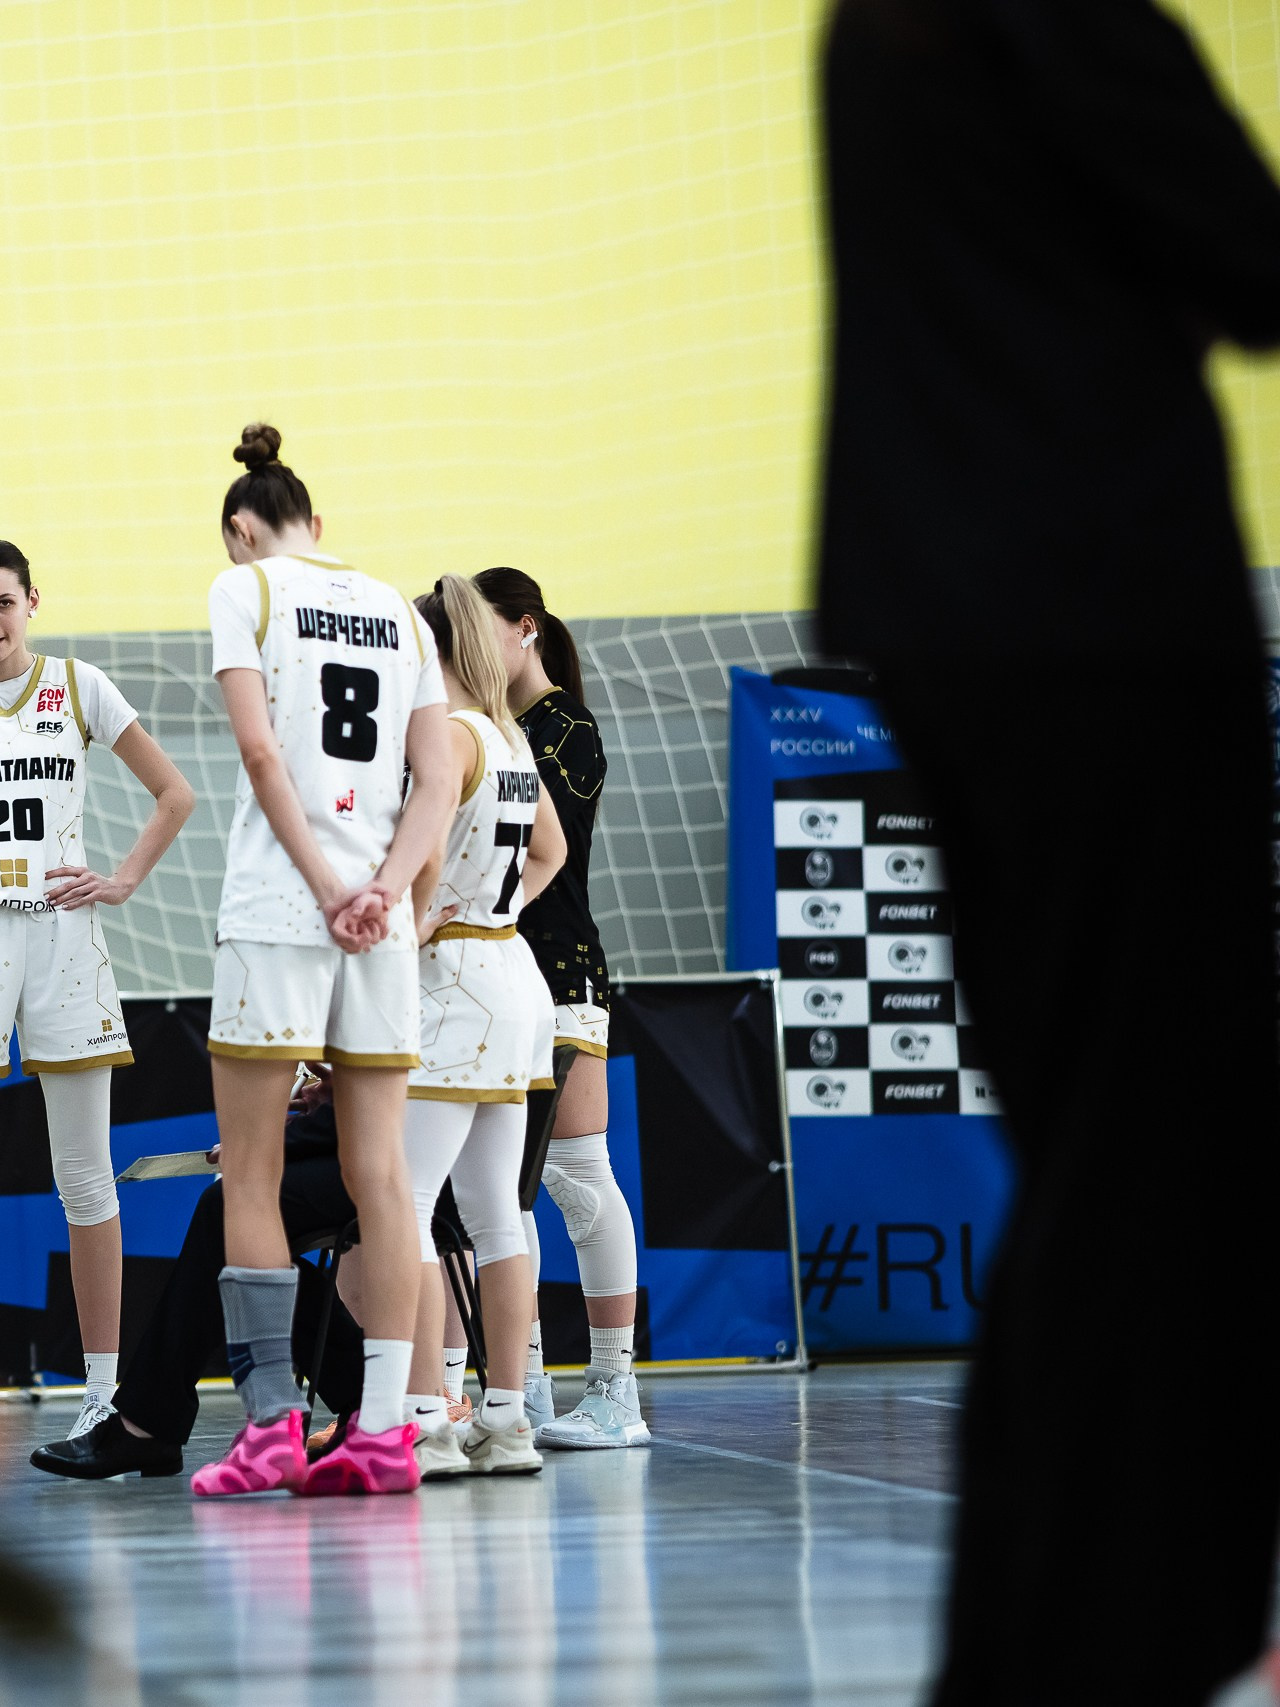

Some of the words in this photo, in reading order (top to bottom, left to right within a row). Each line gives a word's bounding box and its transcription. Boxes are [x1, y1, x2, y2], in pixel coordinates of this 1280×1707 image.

[296, 607, 399, 650] ШЕВЧЕНКО
[38, 687, 65, 701] FON
[36, 699, 63, 713] BET
[321, 662, 379, 762] 8
[770, 739, 855, 756] РОССИИ
[877, 813, 935, 831] FONBET
[879, 904, 938, 920] FONBET
[882, 993, 941, 1009] FONBET
[884, 1083, 945, 1100] FONBET
